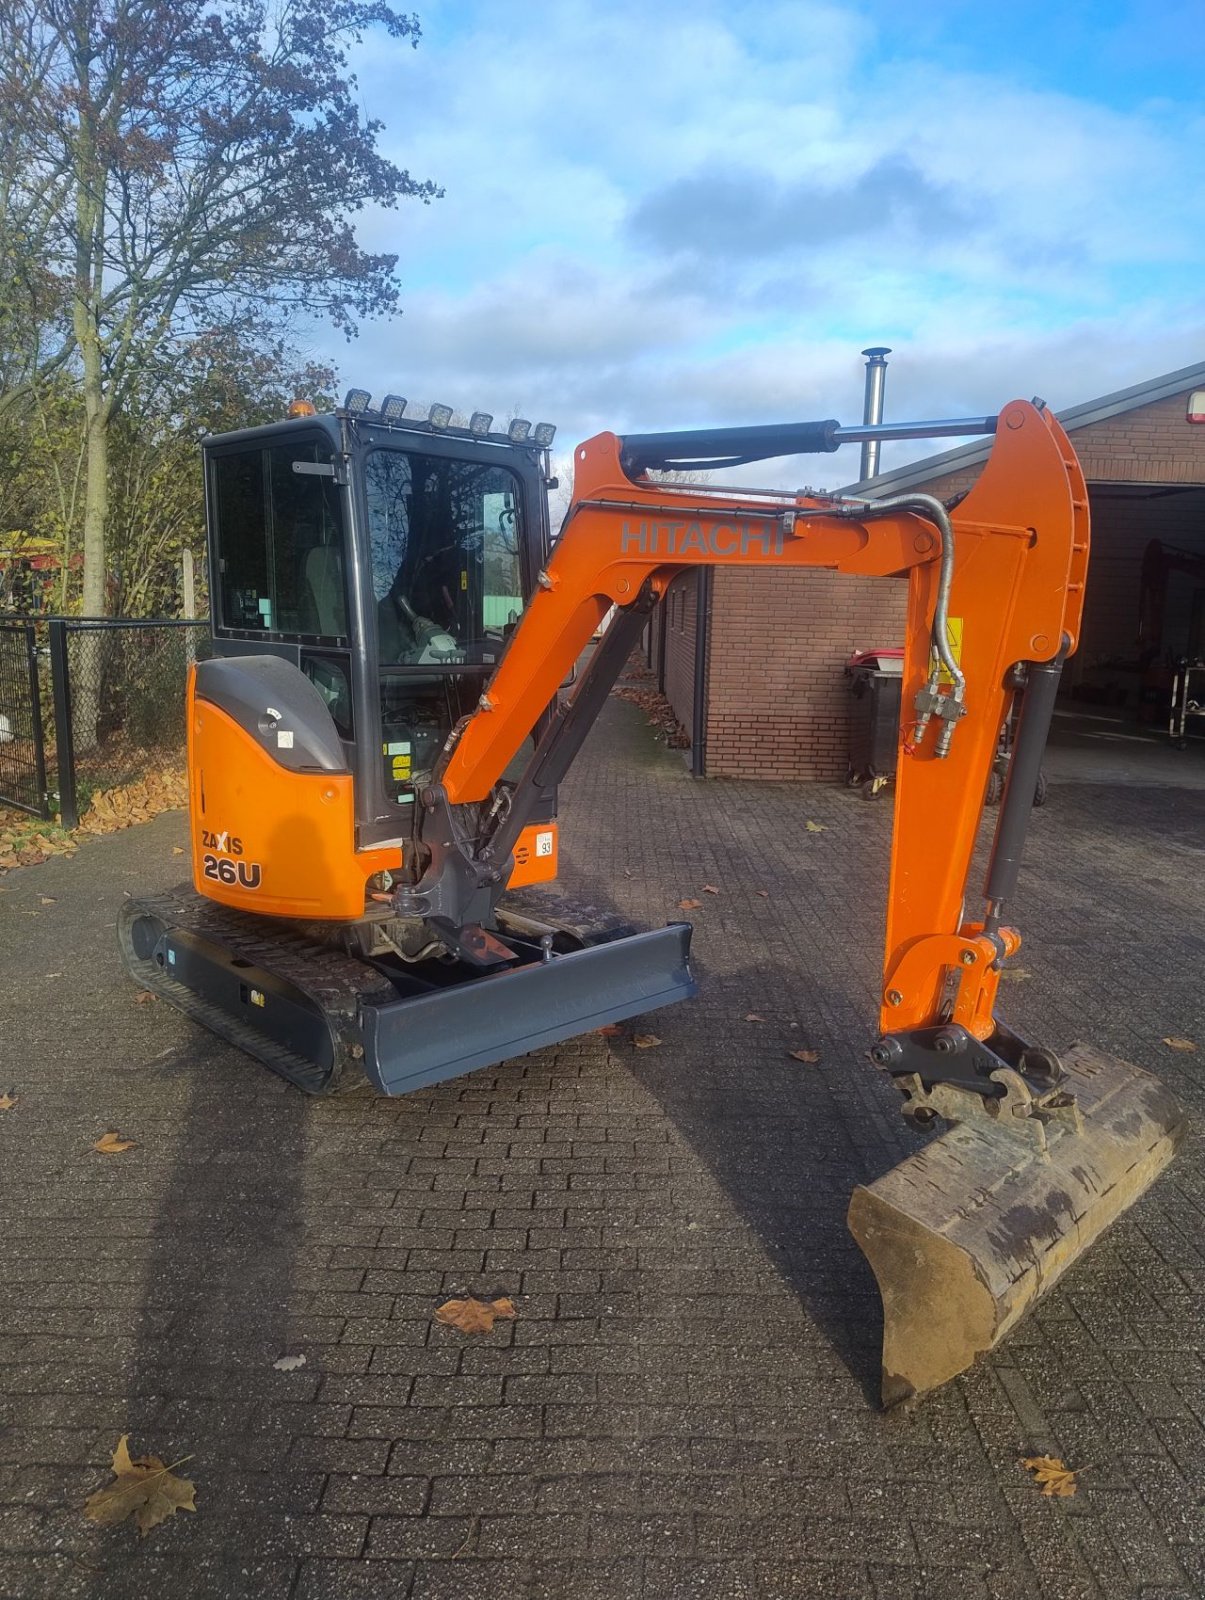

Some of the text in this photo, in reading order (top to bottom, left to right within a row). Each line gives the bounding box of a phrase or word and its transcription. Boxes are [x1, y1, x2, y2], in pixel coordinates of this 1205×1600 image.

[621, 521, 784, 555] HITACHI
[202, 830, 244, 856] ZAXIS
[541, 842, 551, 854] 93
[203, 854, 261, 889] 26U
